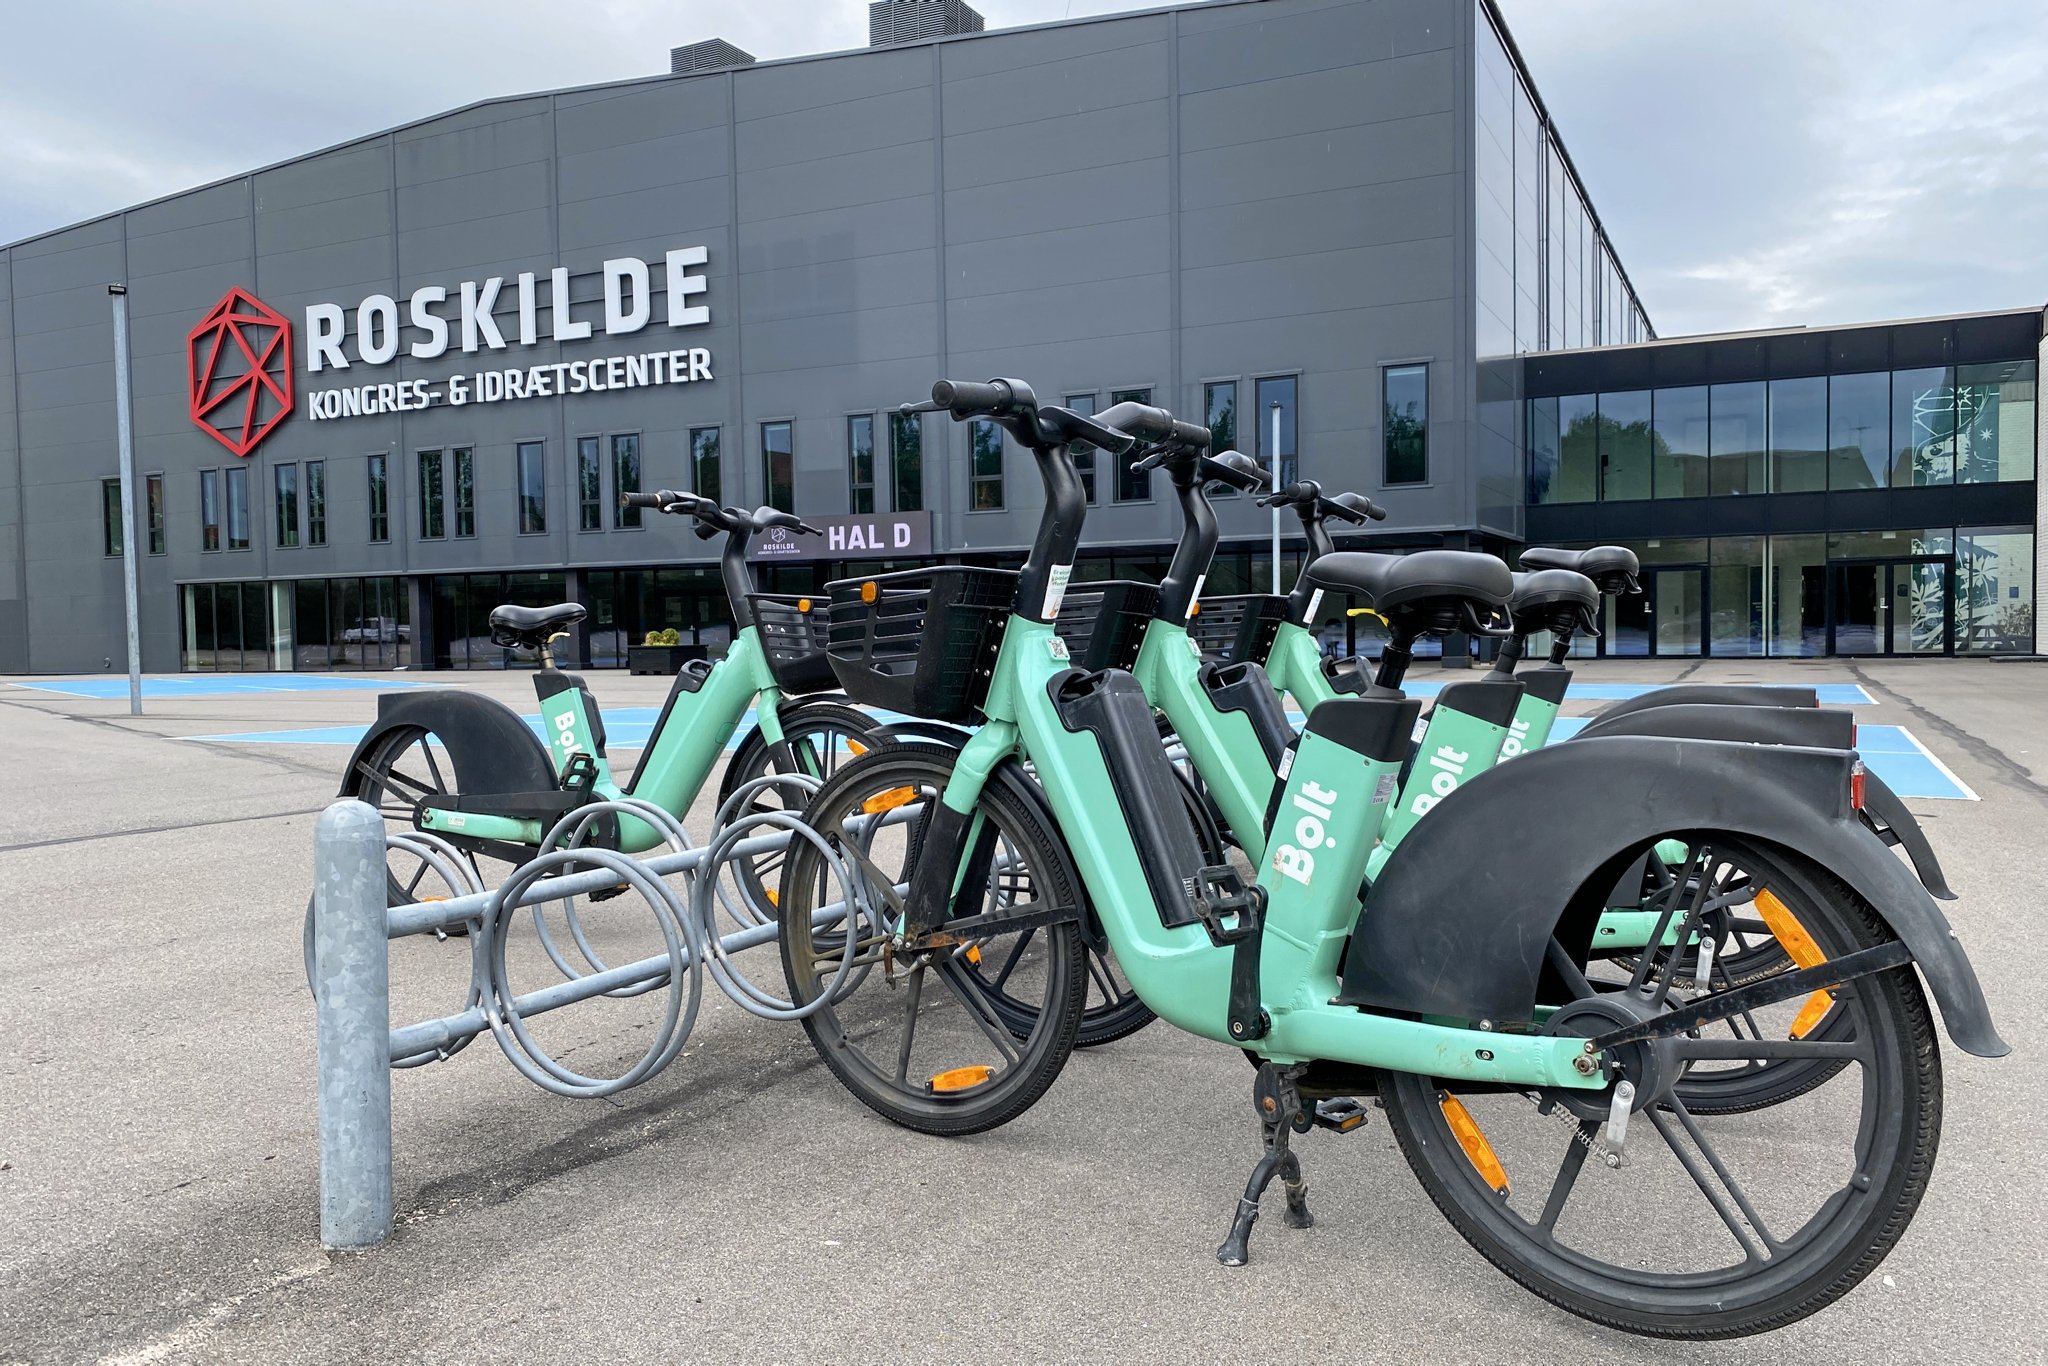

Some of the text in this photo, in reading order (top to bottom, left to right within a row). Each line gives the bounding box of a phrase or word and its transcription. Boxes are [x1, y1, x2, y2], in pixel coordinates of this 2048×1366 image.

[305, 246, 710, 372] ROSKILDE
[308, 347, 713, 421] KONGRES- & IDRÆTSCENTER
[763, 542, 795, 550] ROSKILDE
[828, 522, 911, 551] HAL D
[554, 710, 583, 762] Bol
[1496, 718, 1530, 765] olt
[1272, 780, 1338, 887] Bolt
